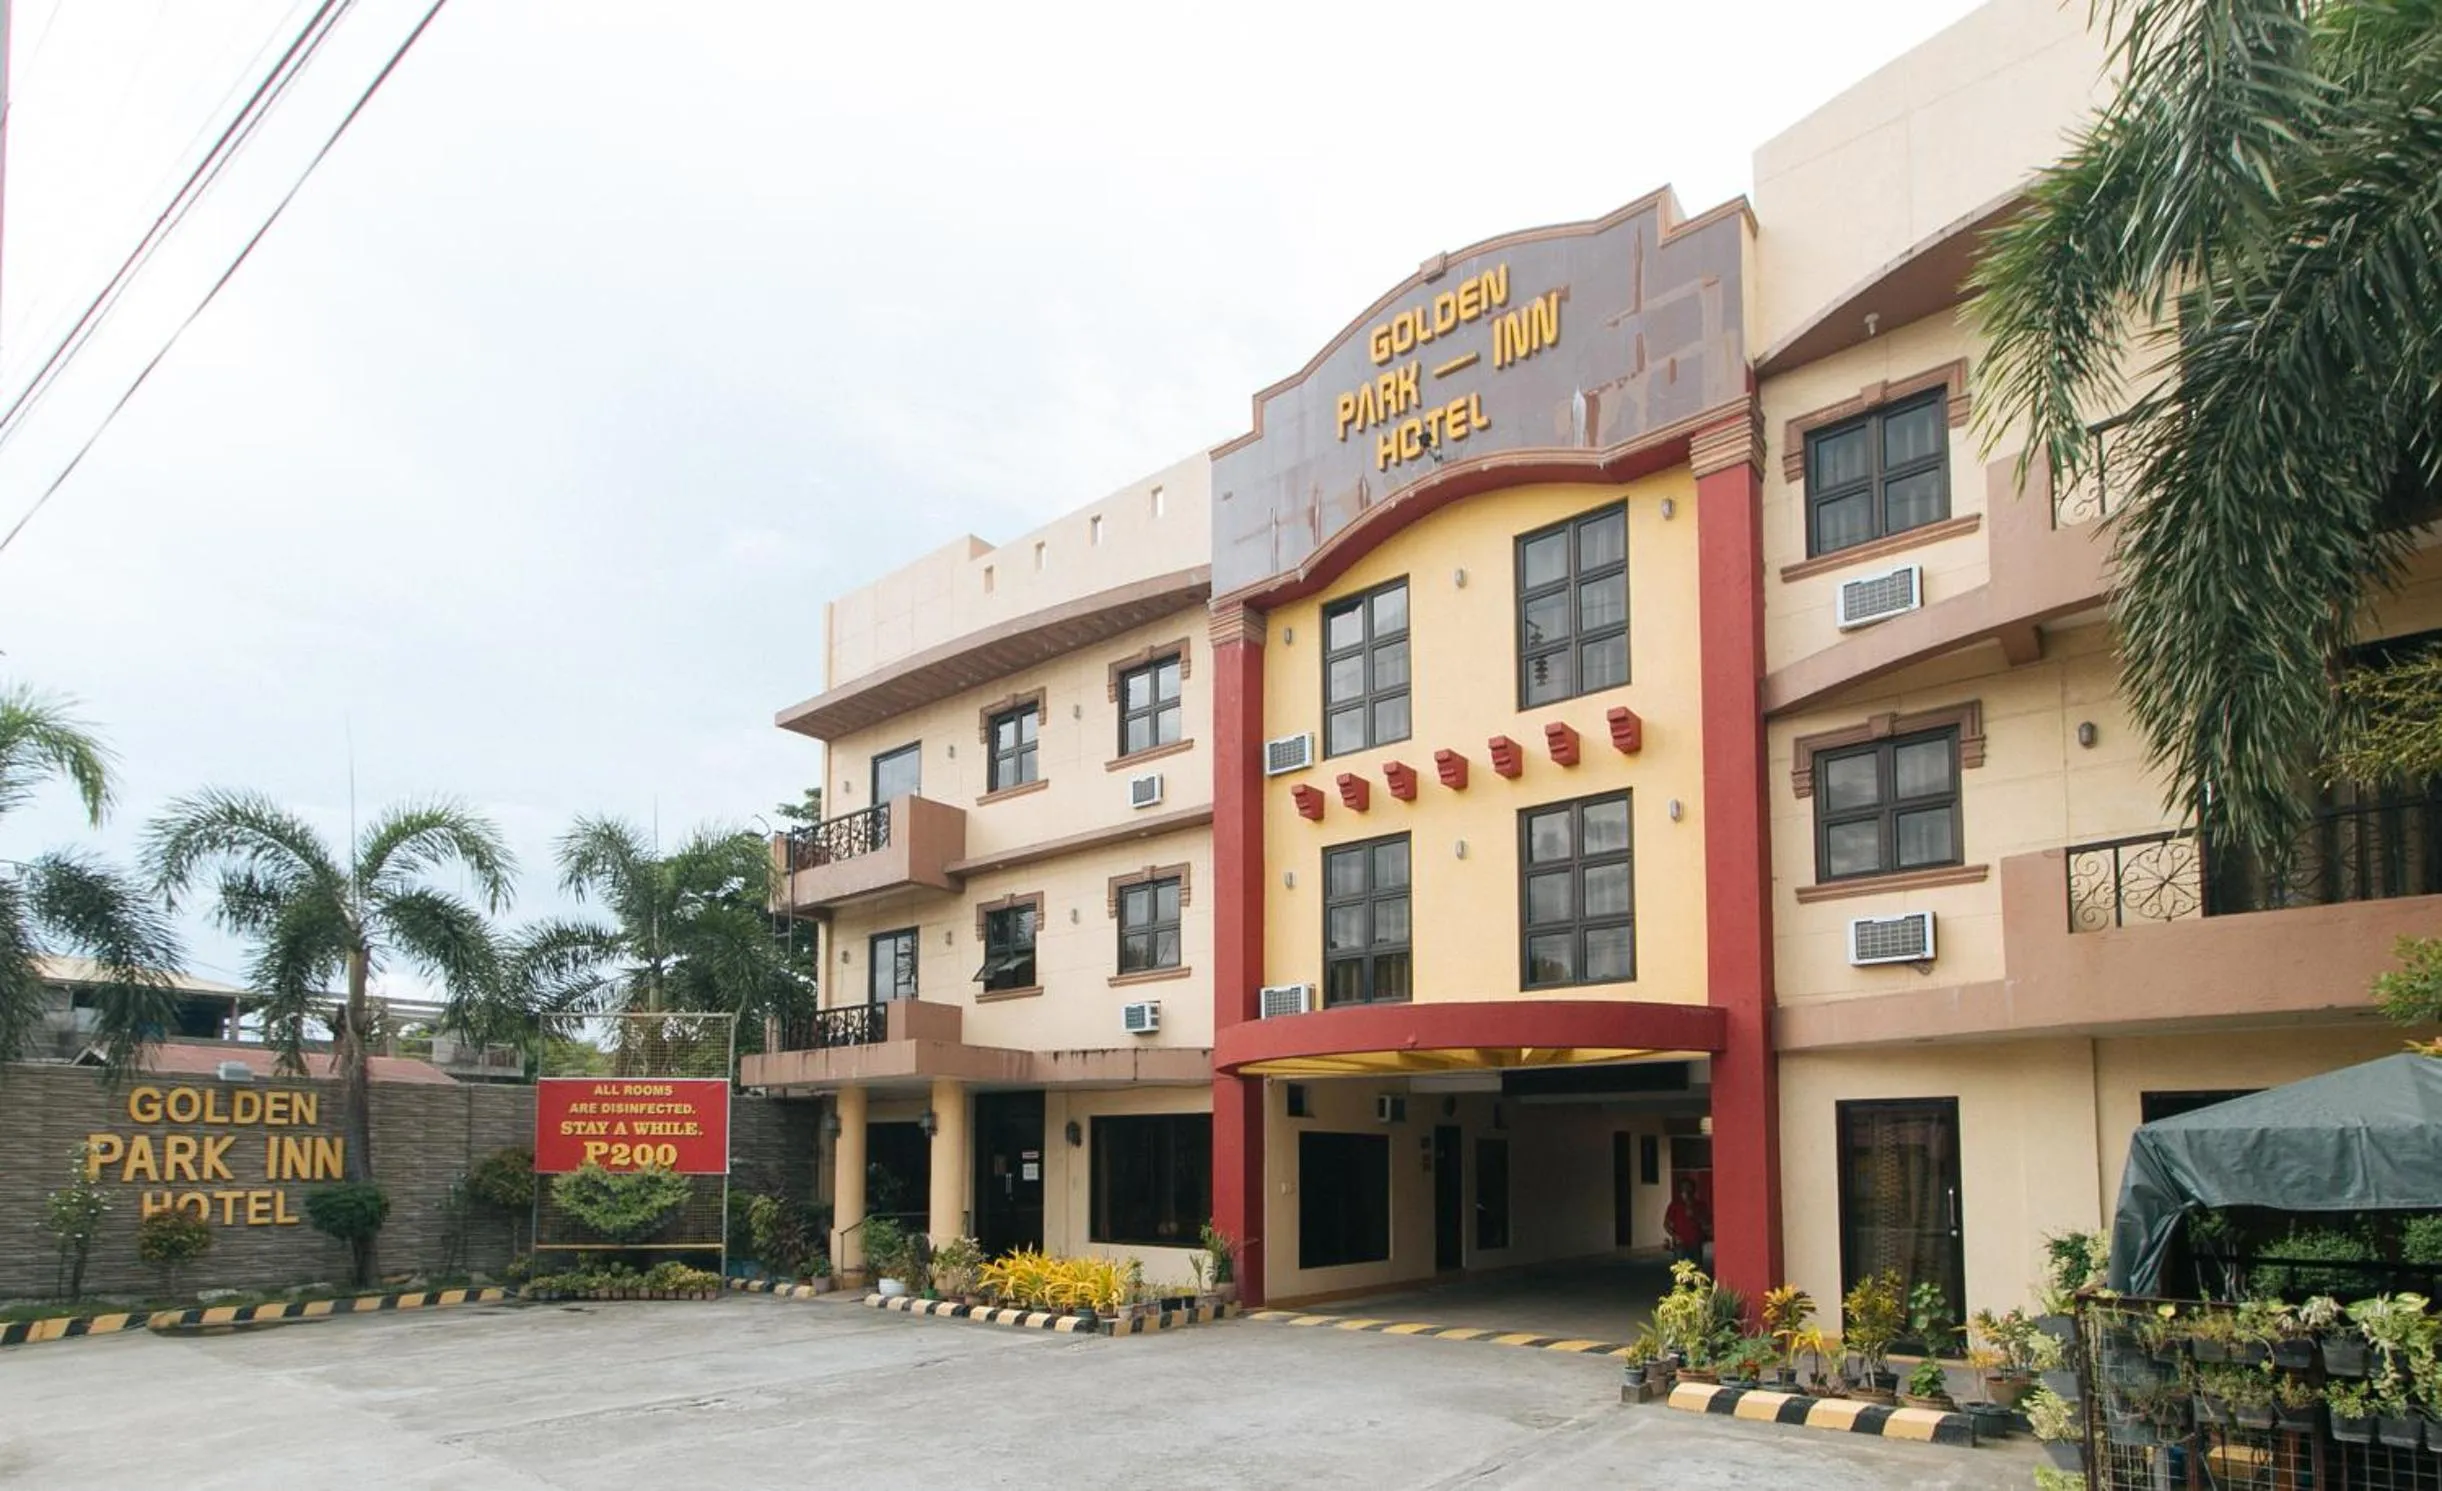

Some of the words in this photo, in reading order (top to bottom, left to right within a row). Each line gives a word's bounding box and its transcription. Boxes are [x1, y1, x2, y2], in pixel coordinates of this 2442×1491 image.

[1369, 263, 1509, 366] GOLDEN
[1337, 359, 1421, 441] PARK
[1494, 291, 1560, 370] INN
[1376, 392, 1491, 471] HOTEL
[128, 1085, 318, 1126] GOLDEN
[568, 1103, 598, 1115] ARE
[601, 1103, 697, 1115] DISINFECTED.
[594, 1084, 620, 1096] ALL
[624, 1084, 674, 1096] ROOMS
[560, 1120, 611, 1136] STAY
[613, 1120, 629, 1136] A
[632, 1121, 704, 1136] WHILE.
[86, 1132, 236, 1182] PARK
[266, 1135, 344, 1181] INN
[583, 1140, 678, 1168] P200
[141, 1189, 300, 1226] HOTEL
